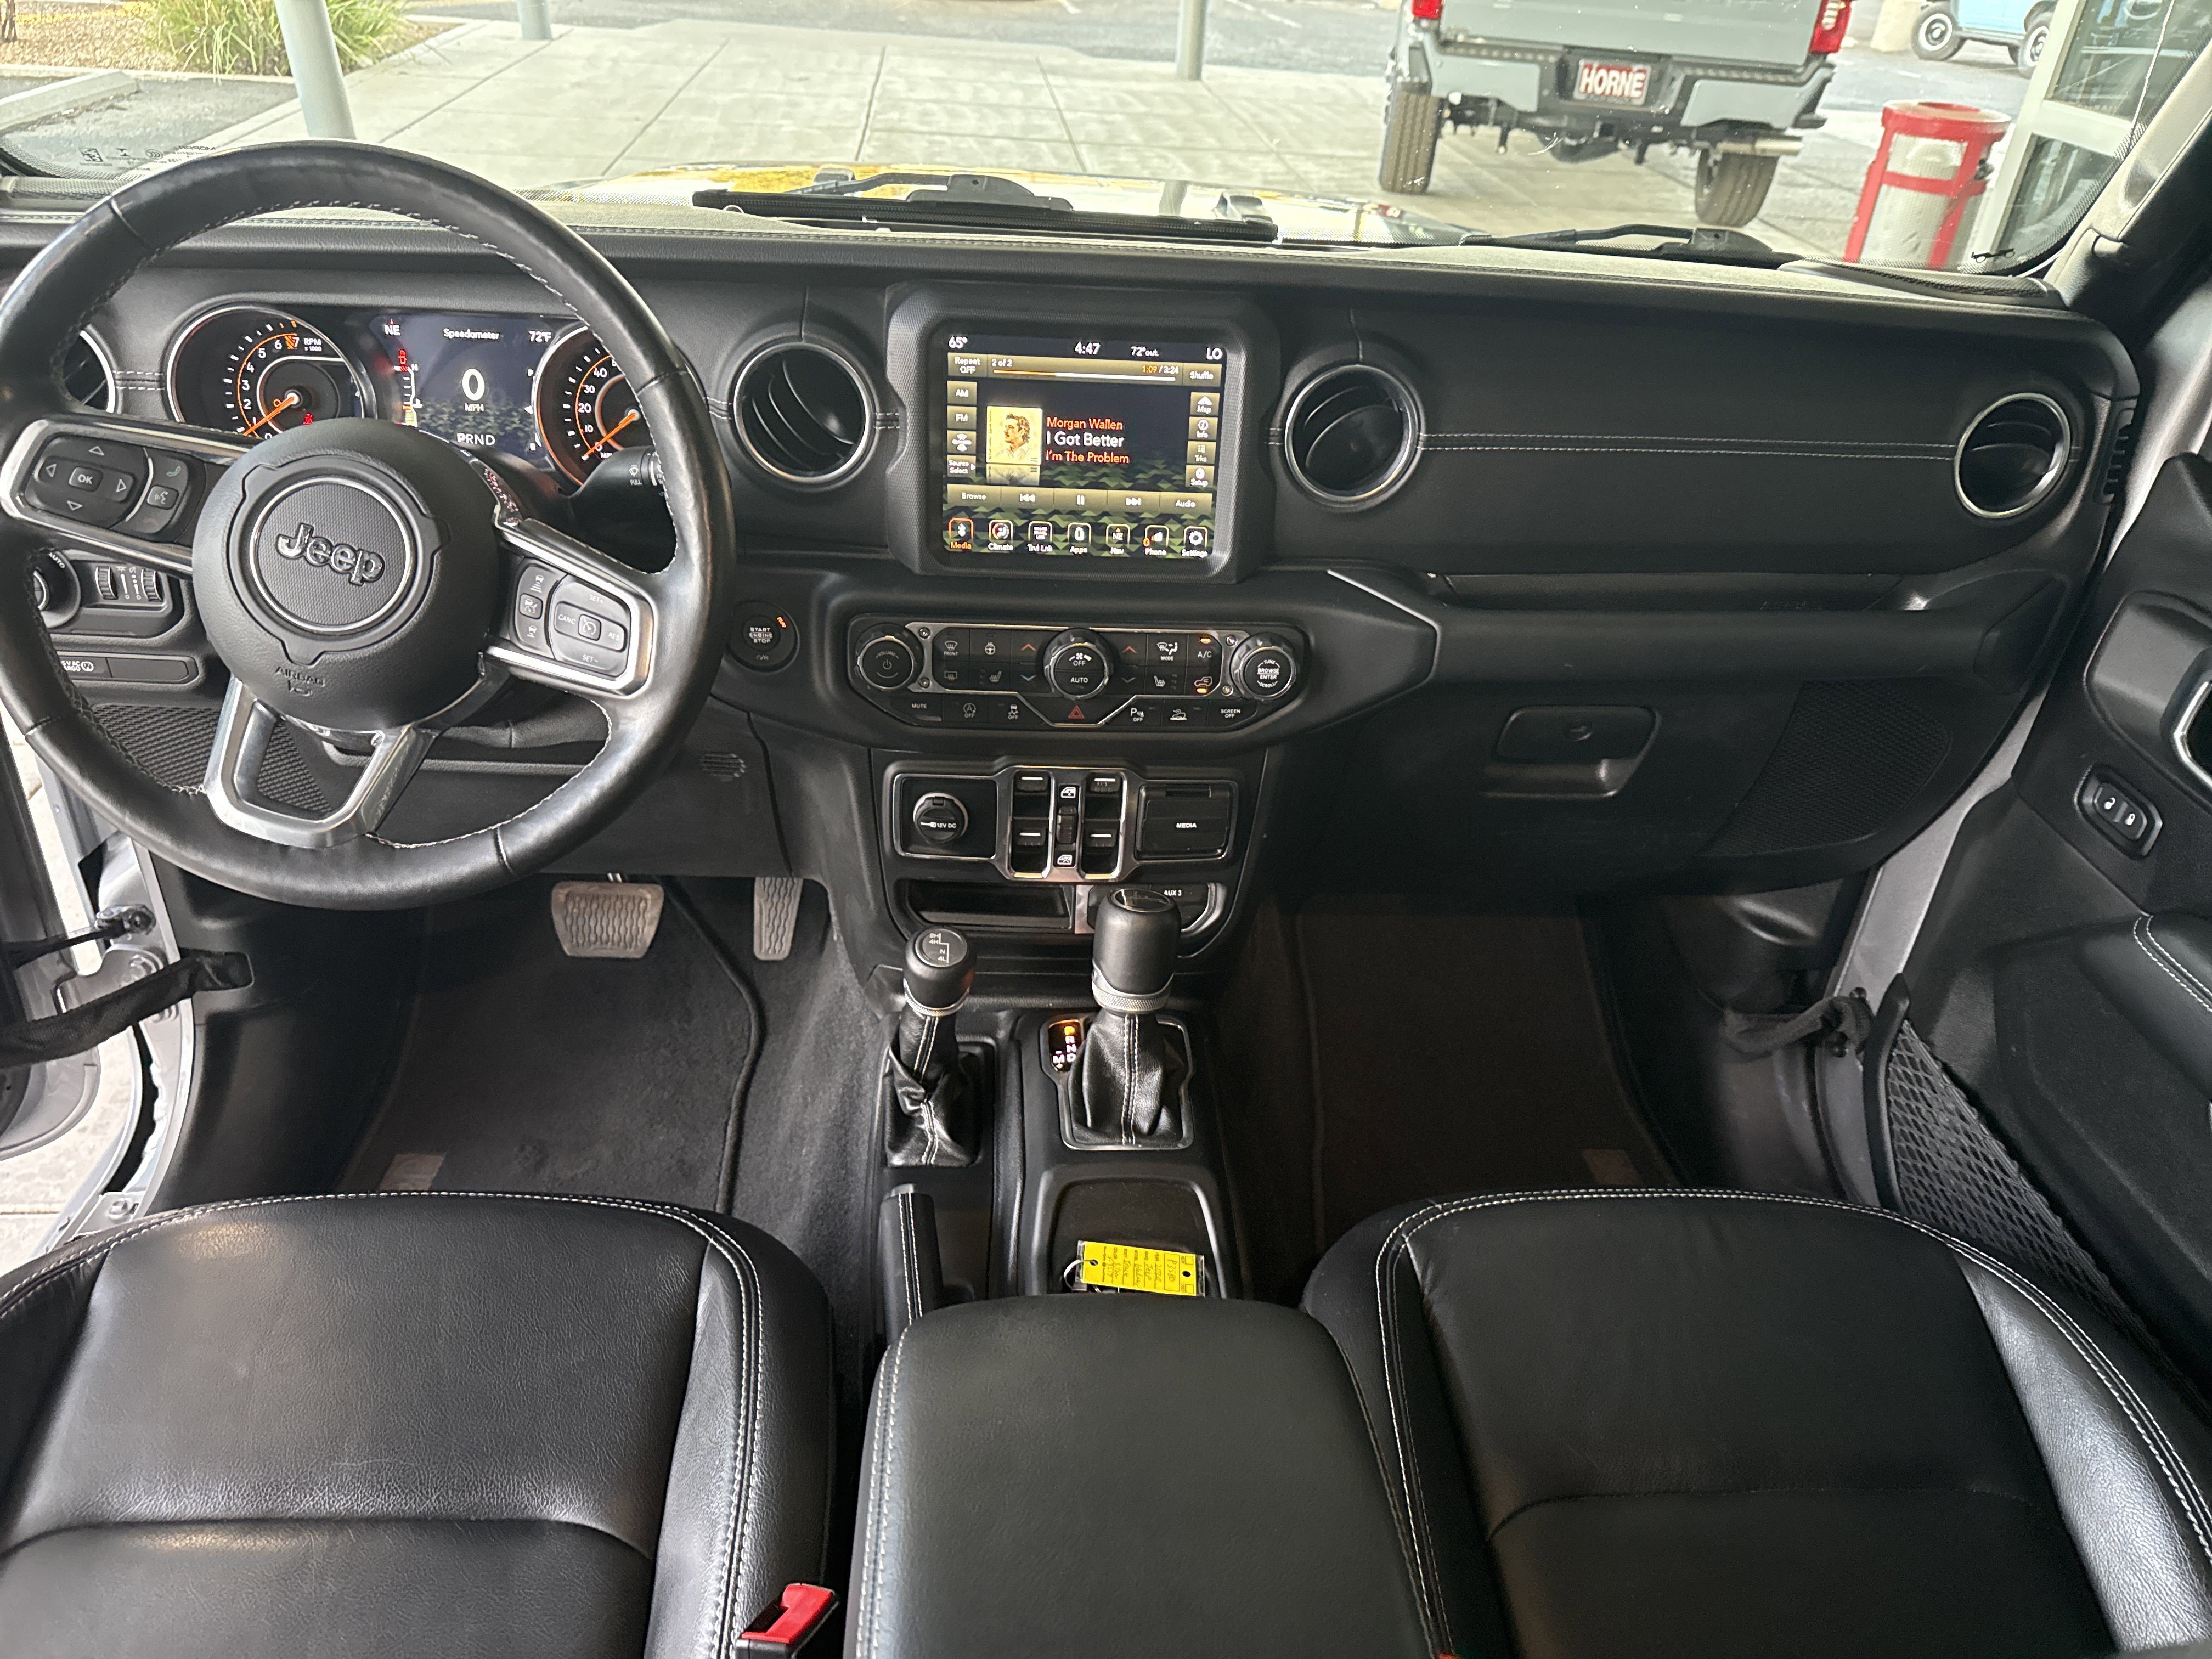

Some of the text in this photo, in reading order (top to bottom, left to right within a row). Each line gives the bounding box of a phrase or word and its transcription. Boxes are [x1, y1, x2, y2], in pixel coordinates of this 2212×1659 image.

[1579, 68, 1646, 98] HORNE
[385, 325, 400, 335] NE
[443, 328, 500, 340] Speedometer
[274, 340, 282, 350] 6
[292, 337, 299, 348] 7
[949, 336, 968, 348] 65°
[258, 347, 266, 358] 5
[1075, 342, 1100, 355] 4:47
[1206, 347, 1223, 360] LO
[955, 357, 980, 365] Repeat
[246, 362, 255, 373] 4
[593, 368, 607, 378] 40
[1190, 371, 1214, 380] Shuffle
[241, 380, 250, 391] 3
[462, 368, 485, 401] 0
[584, 385, 595, 394] 30
[955, 389, 968, 397] AM
[244, 399, 251, 410] 2
[465, 403, 484, 412] MPH
[578, 403, 592, 413] 20
[1197, 405, 1211, 414] Map
[956, 414, 968, 422] FM
[1047, 417, 1123, 430] Morgan Wallen
[584, 425, 594, 433] 10
[456, 432, 496, 445] PRND
[1047, 431, 1124, 447] I Got Better
[1064, 450, 1084, 462] The
[1087, 452, 1130, 464] Problem
[78, 475, 93, 485] OK
[1190, 478, 1209, 487] Setup
[277, 523, 384, 586] Jeep
[1181, 549, 1207, 557] Settings
[48, 552, 65, 569] AUTO
[558, 614, 576, 625] CANC
[777, 616, 787, 628] RUN
[608, 631, 620, 640] RES
[275, 667, 326, 687] AIRBAG
[1065, 1035, 1075, 1044] R
[1066, 1043, 1076, 1053] N
[1053, 1054, 1065, 1064] M
[1066, 1053, 1076, 1062] D
